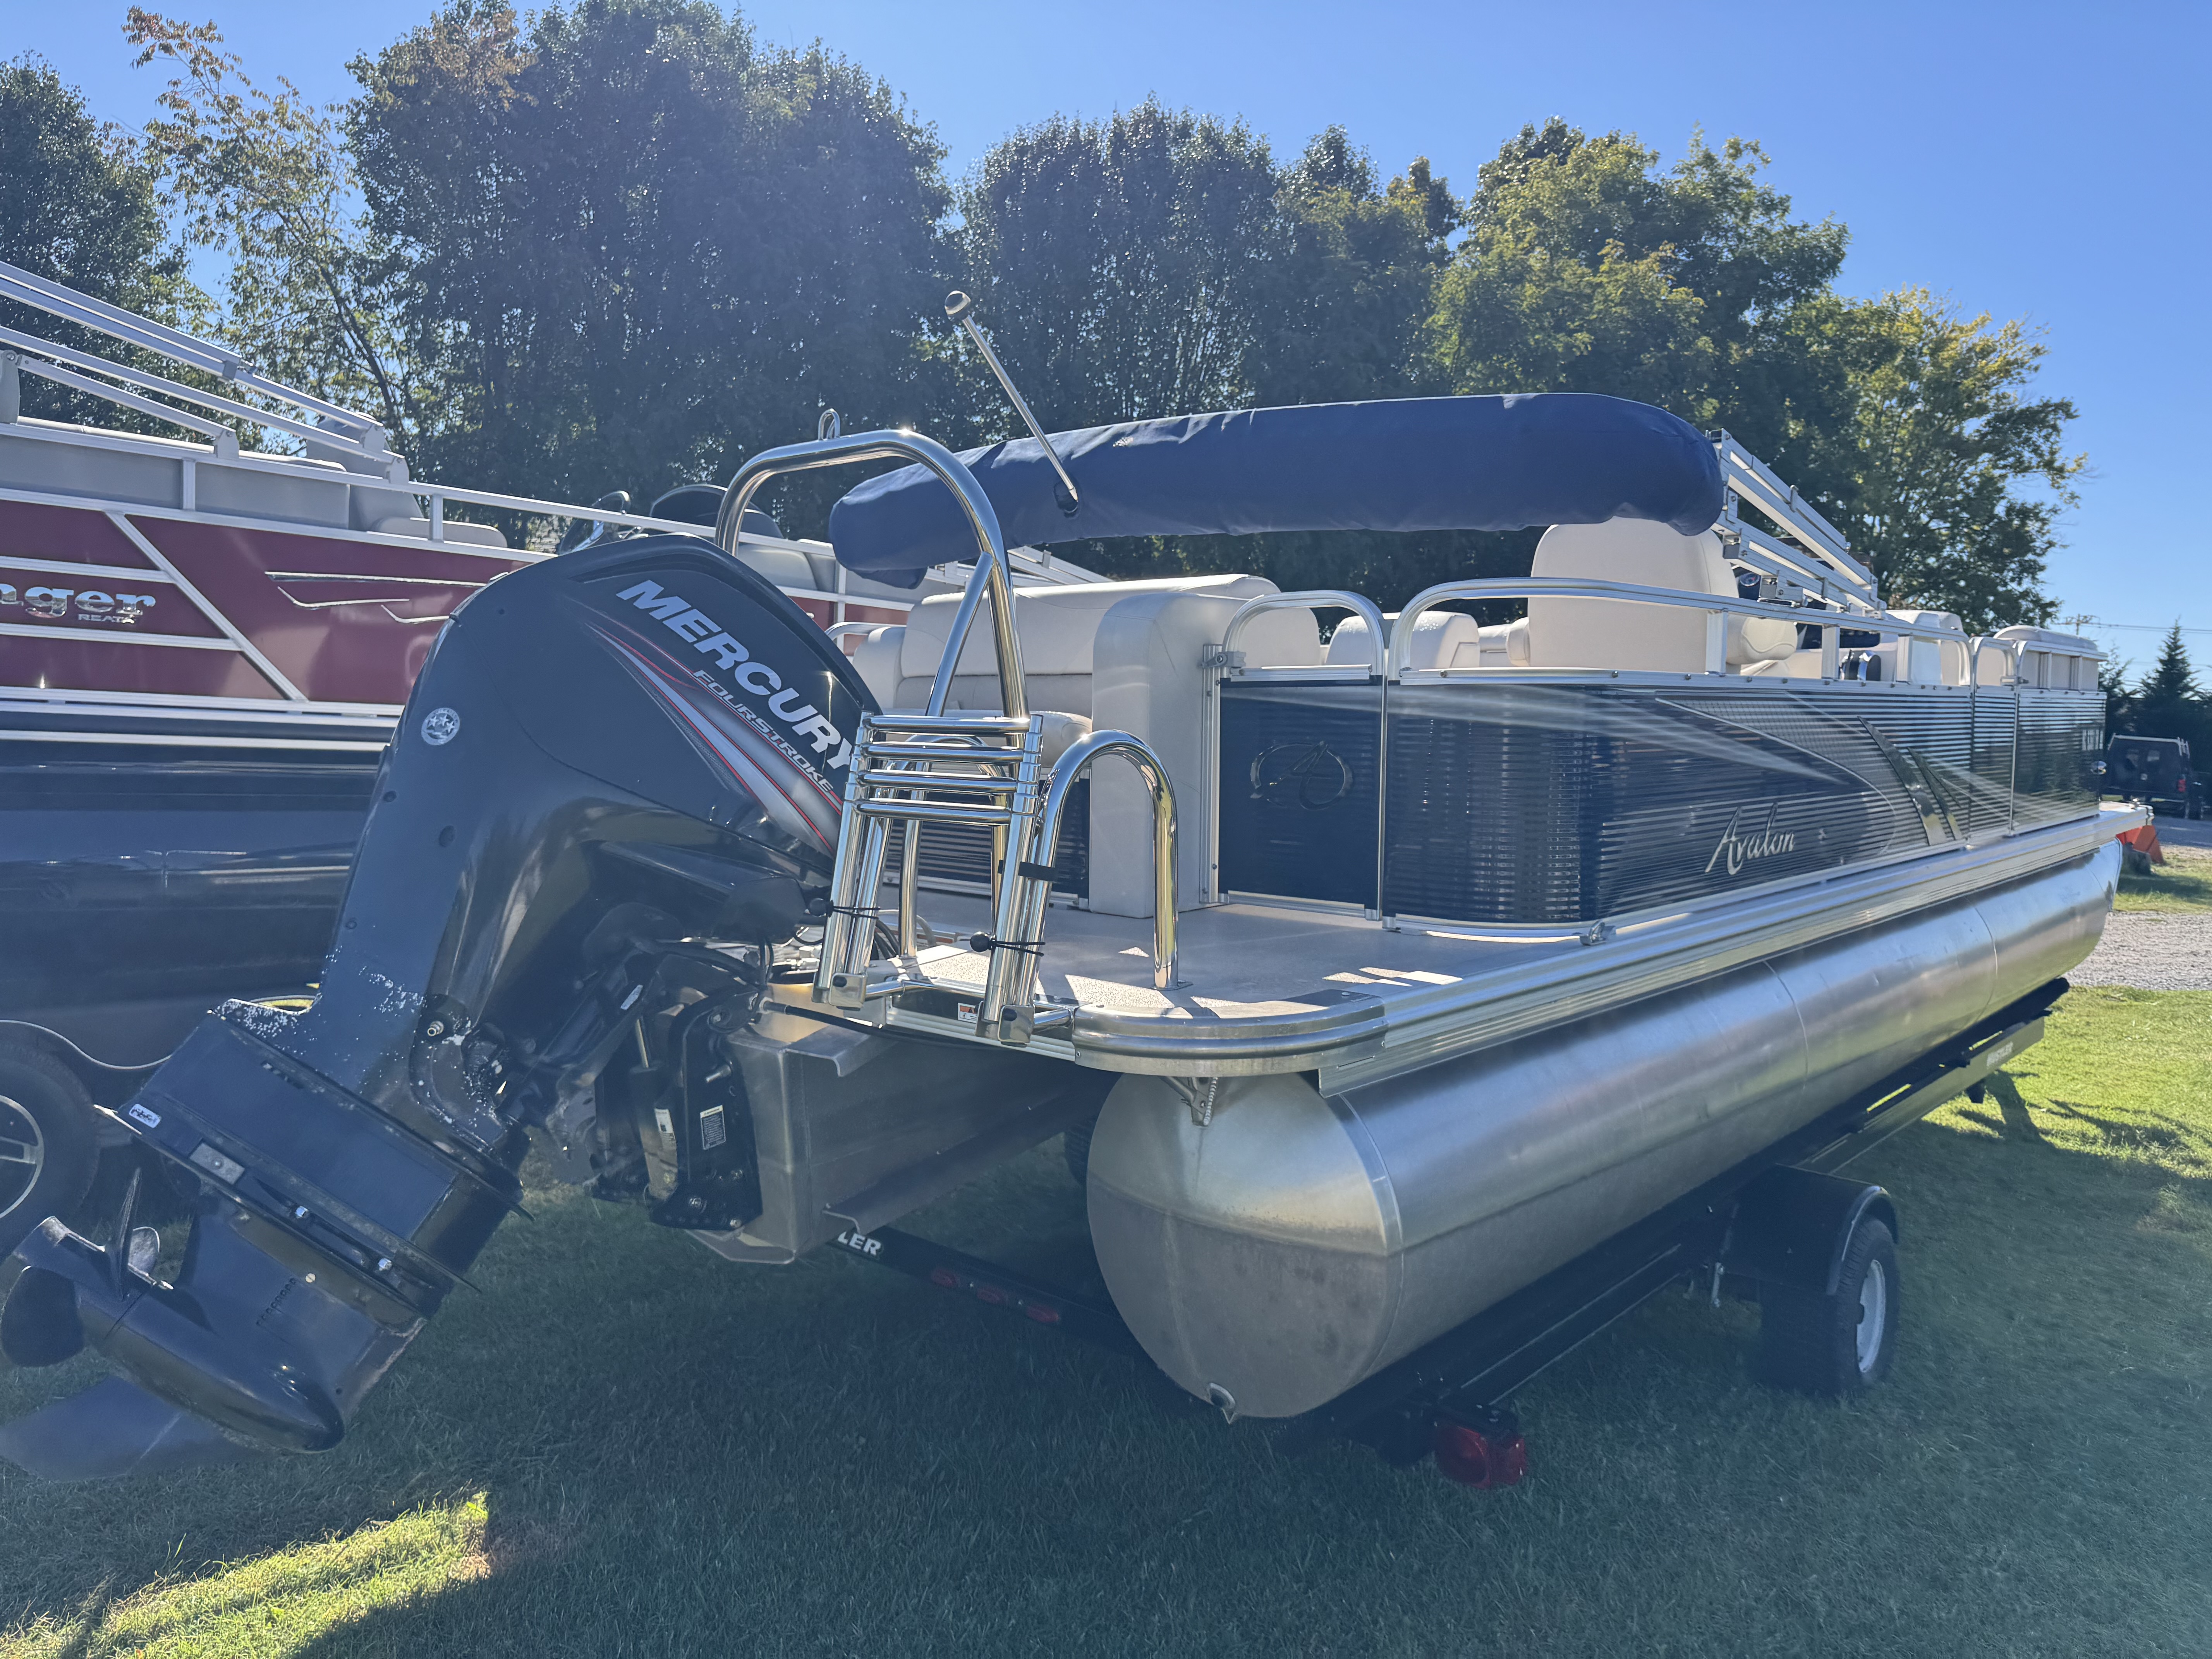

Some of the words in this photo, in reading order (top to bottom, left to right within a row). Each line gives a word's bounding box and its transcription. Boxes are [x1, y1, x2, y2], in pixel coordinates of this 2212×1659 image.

[616, 579, 852, 769] MERCURY
[693, 670, 834, 792] FOURSTROKE
[1704, 802, 1795, 875] Avalon
